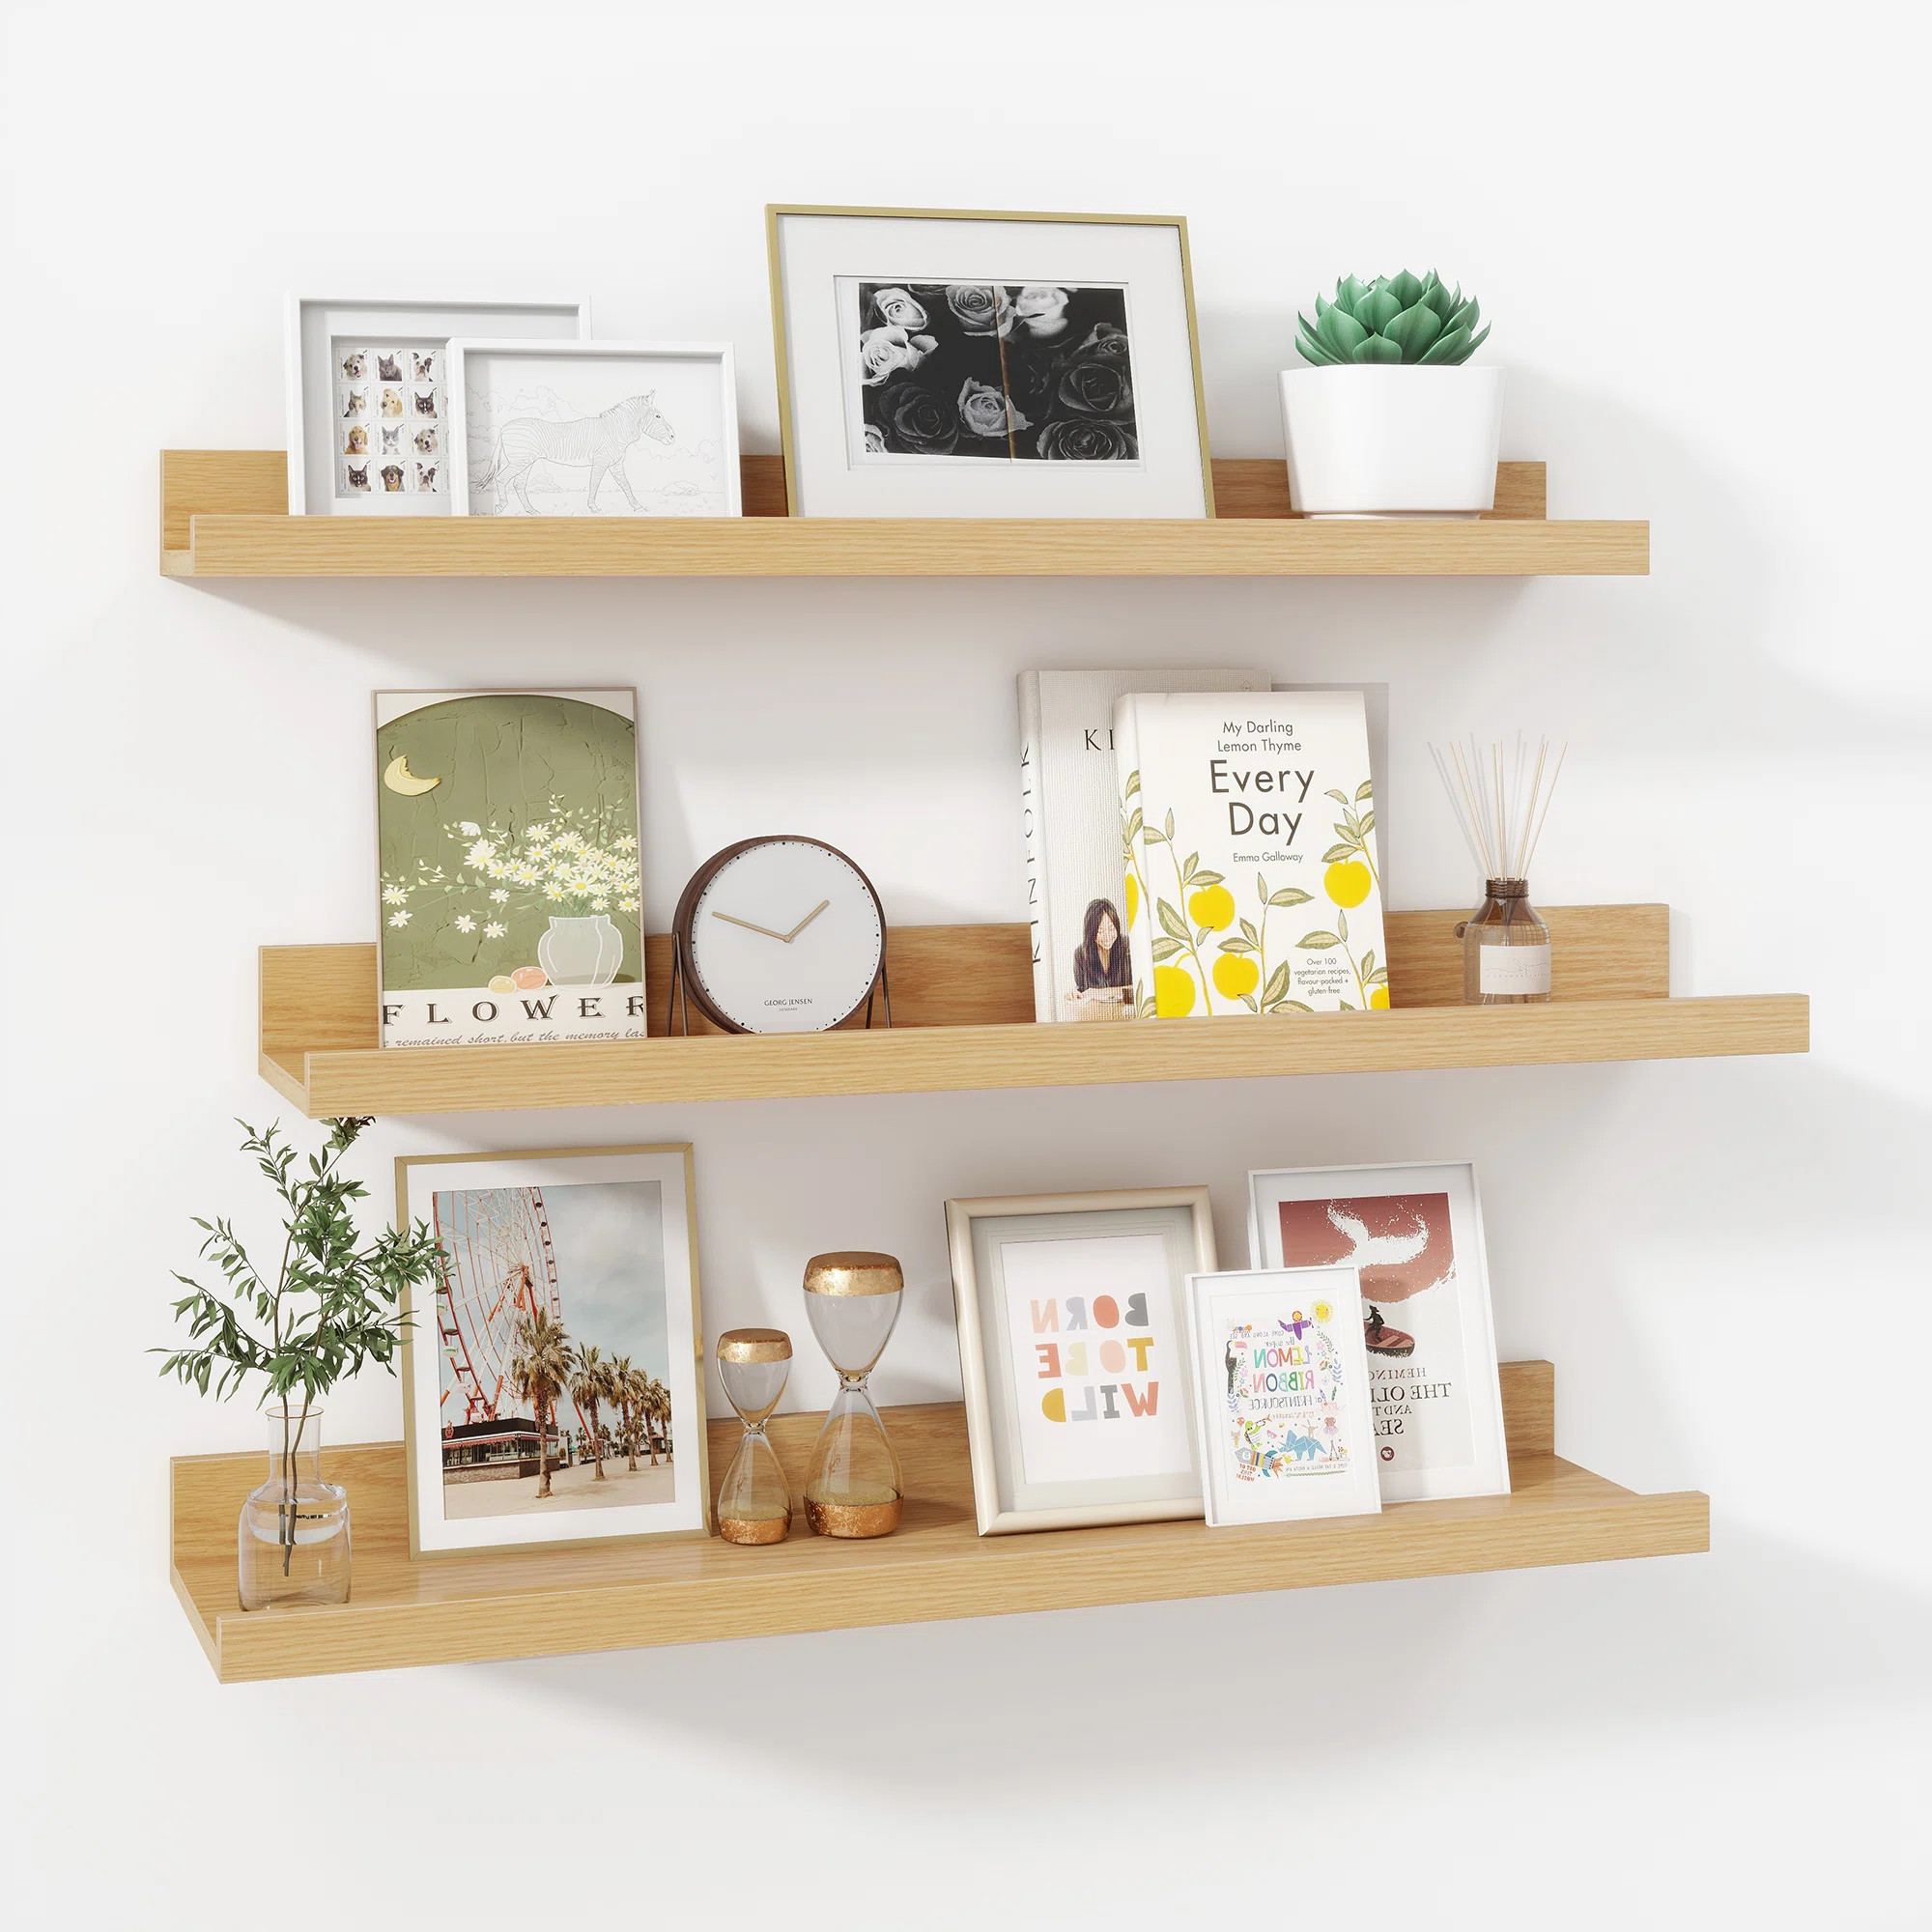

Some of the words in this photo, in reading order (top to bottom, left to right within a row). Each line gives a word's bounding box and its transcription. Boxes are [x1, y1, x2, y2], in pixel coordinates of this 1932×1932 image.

[1223, 722, 1242, 737] My
[1246, 719, 1293, 736] Darling
[1217, 739, 1257, 753] Lemon
[1261, 737, 1302, 754] Thyme
[1209, 759, 1315, 803] Every
[1229, 802, 1303, 846] Day
[1233, 852, 1260, 863] Emma
[1262, 851, 1303, 864] Galloway
[1294, 968, 1326, 977] vegetarian
[1327, 967, 1351, 976] recipes,
[1307, 986, 1341, 996] gluten-free
[383, 994, 644, 1026] FLOWER
[395, 1035, 463, 1046] remained
[538, 1030, 559, 1041] the
[565, 1032, 619, 1040] memory
